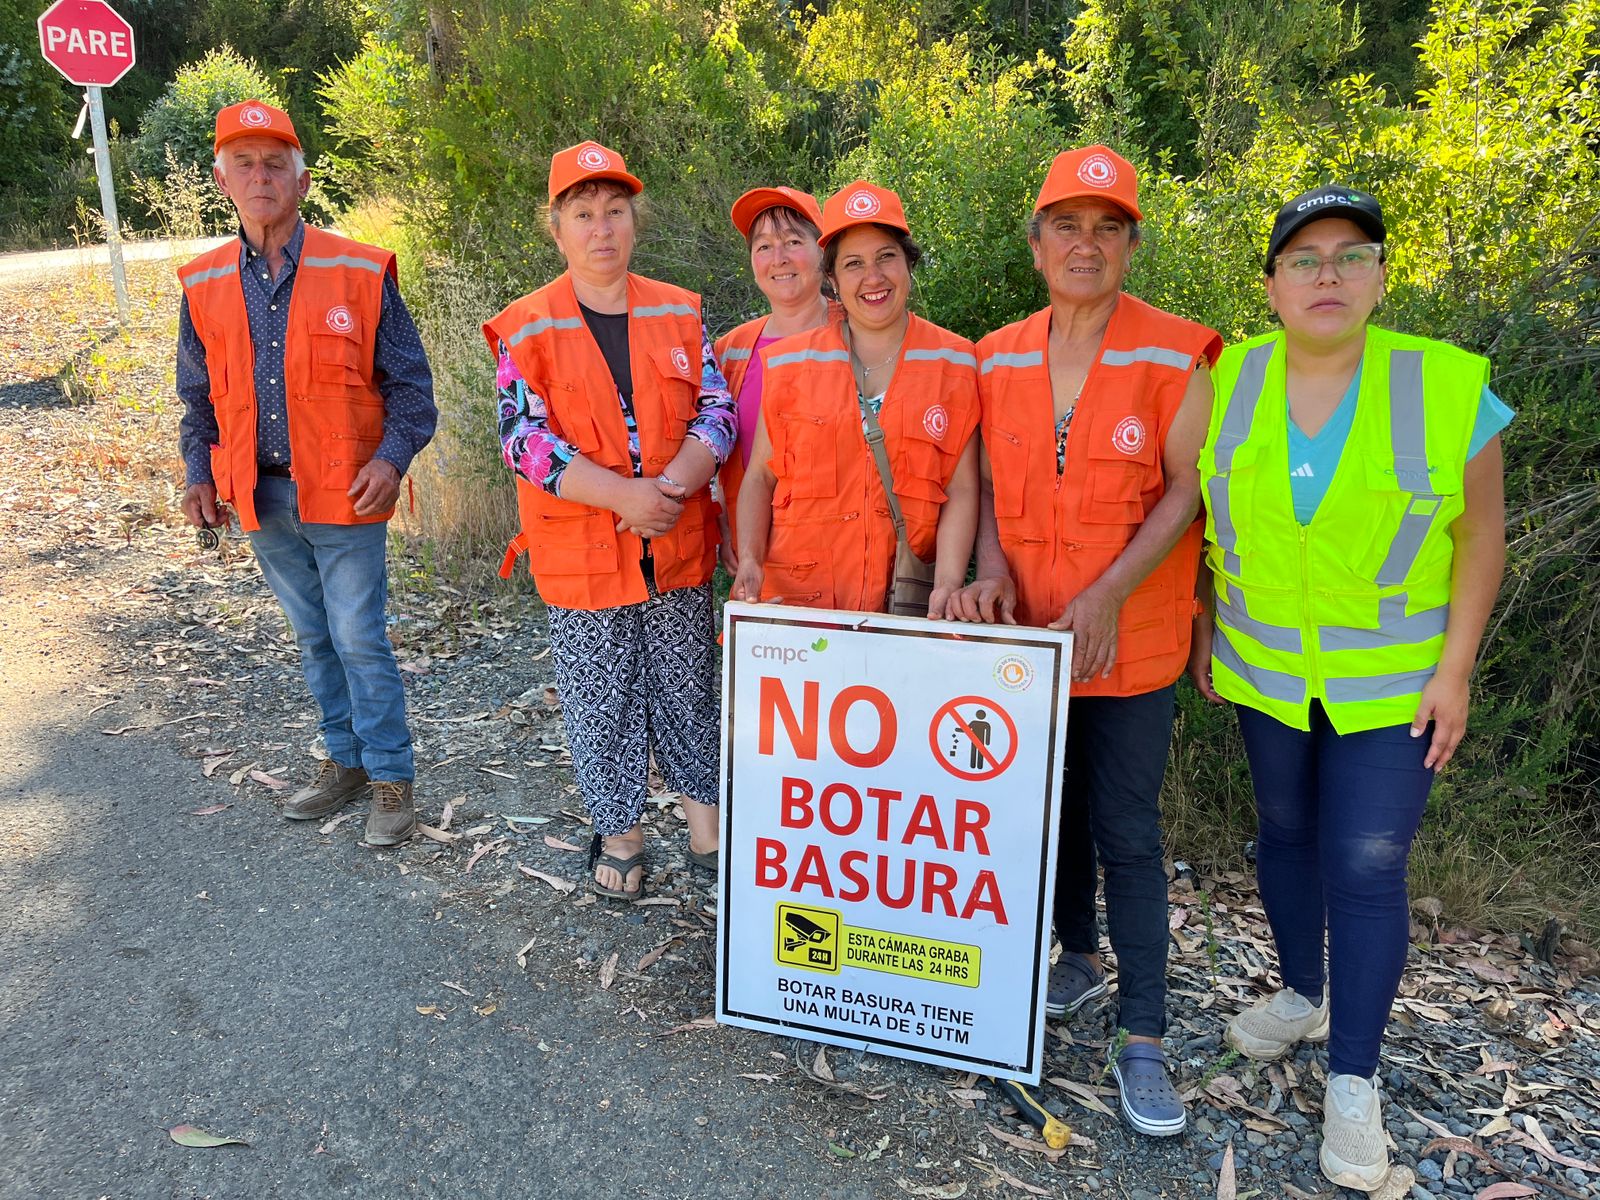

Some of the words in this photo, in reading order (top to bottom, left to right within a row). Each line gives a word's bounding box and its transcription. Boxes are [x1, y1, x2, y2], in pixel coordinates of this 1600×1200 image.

[46, 25, 128, 58] PARE
[751, 644, 808, 665] cmpc
[758, 676, 898, 768] NO
[780, 776, 991, 856] BOTAR
[755, 837, 1009, 926] BASURA
[811, 949, 829, 962] 24H
[847, 947, 899, 968] DURANTE
[902, 959, 924, 971] LAS
[929, 961, 943, 975] 24
[945, 964, 968, 979] HRS
[848, 932, 876, 949] ESTA
[878, 937, 926, 957] CÁMARA
[929, 946, 970, 964] GRABA
[778, 978, 836, 1000] BOTAR
[842, 989, 916, 1015] BASURA
[921, 1003, 974, 1026] TIENE
[783, 997, 819, 1016] UNA
[824, 1005, 881, 1028] MULTA
[886, 1016, 910, 1034] DE
[915, 1024, 925, 1035] 5
[931, 1026, 969, 1045] UTM
